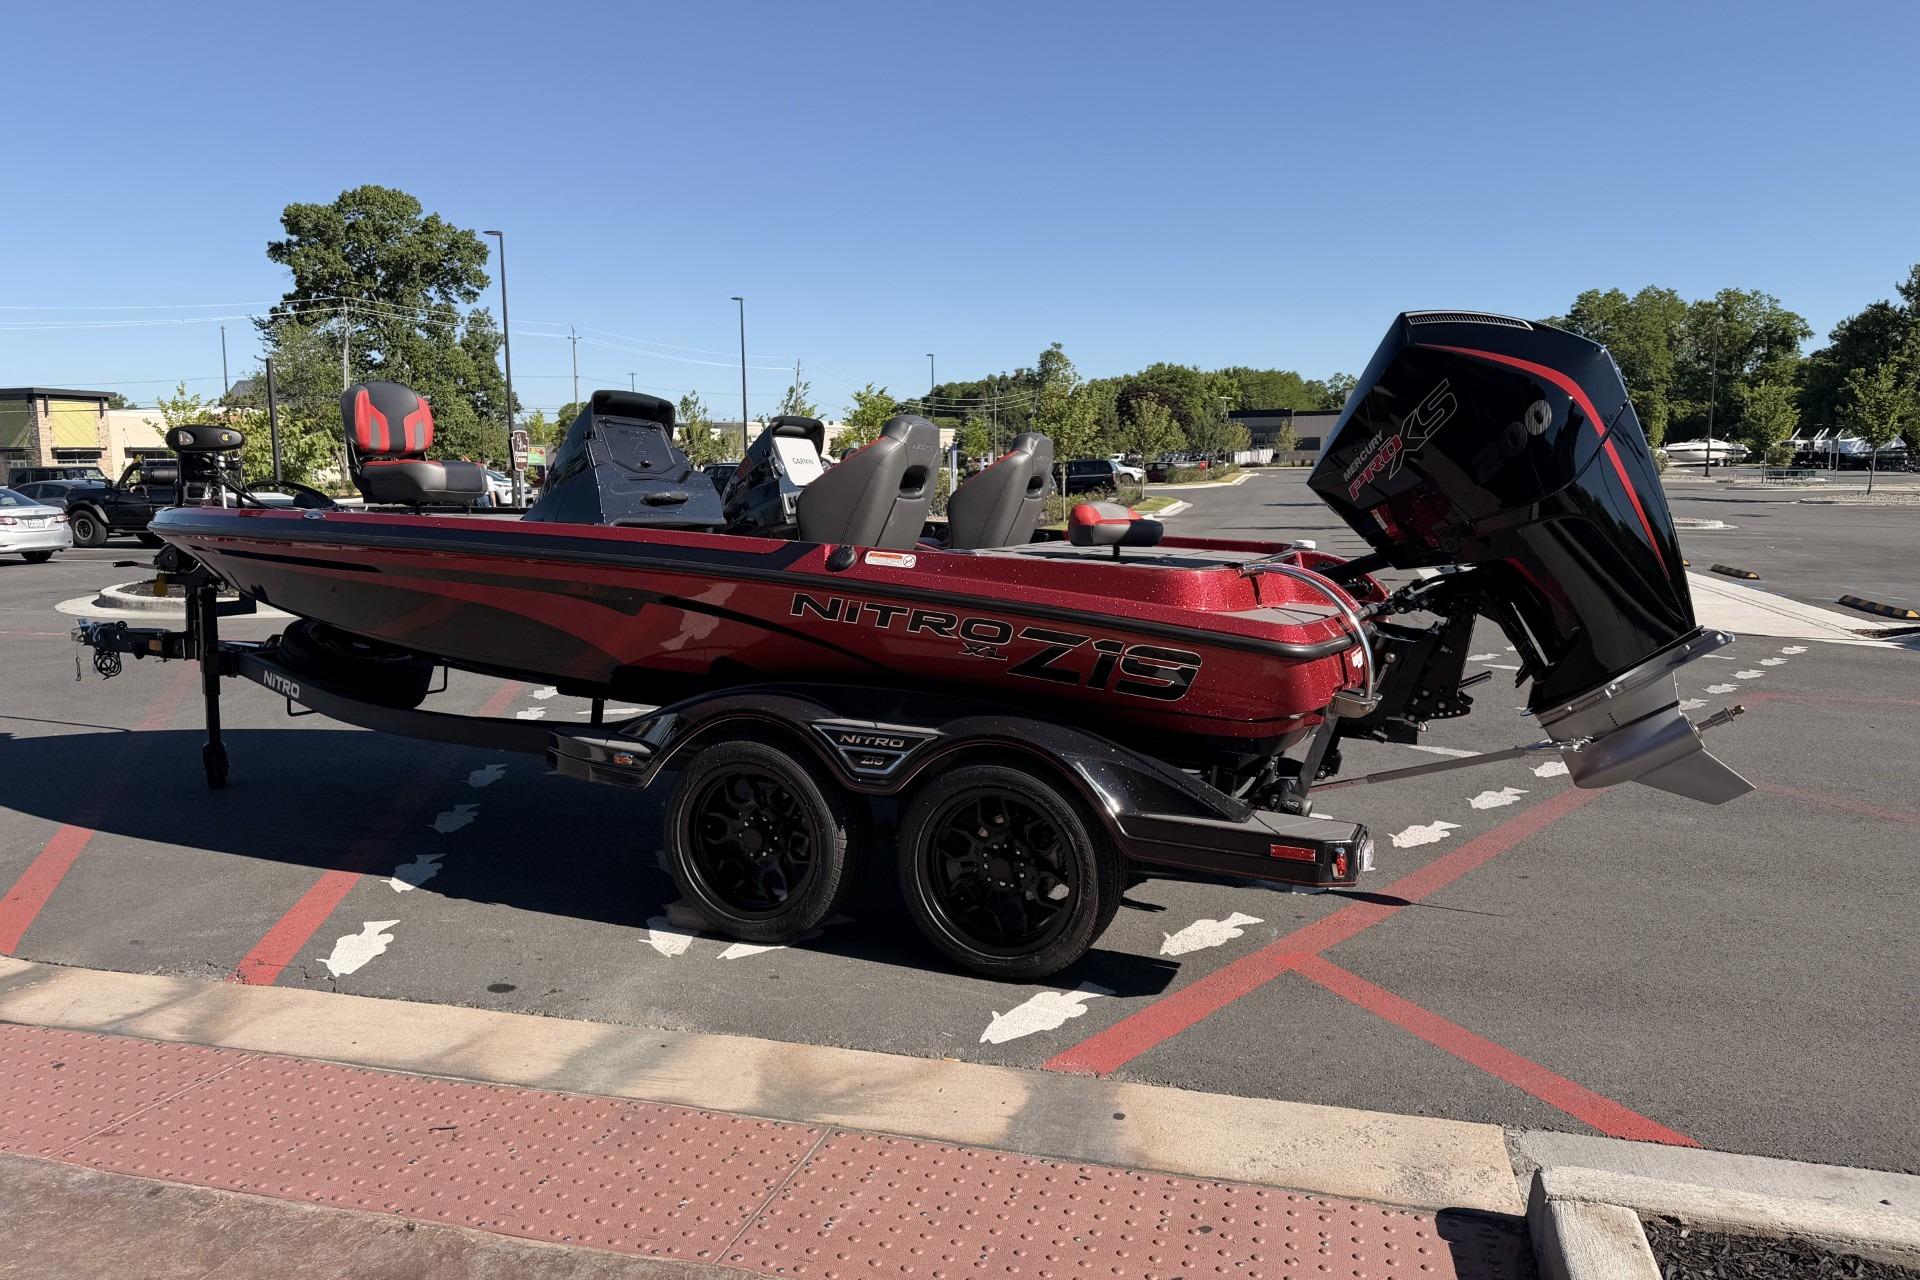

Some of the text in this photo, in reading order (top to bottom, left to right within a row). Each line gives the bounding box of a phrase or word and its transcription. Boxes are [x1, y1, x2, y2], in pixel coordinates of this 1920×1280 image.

[1343, 429, 1385, 482] MERCURY
[790, 592, 1203, 701] NITRO Z19
[958, 642, 1009, 661] XL
[263, 669, 300, 699] NITRO
[840, 733, 906, 749] NITRO
